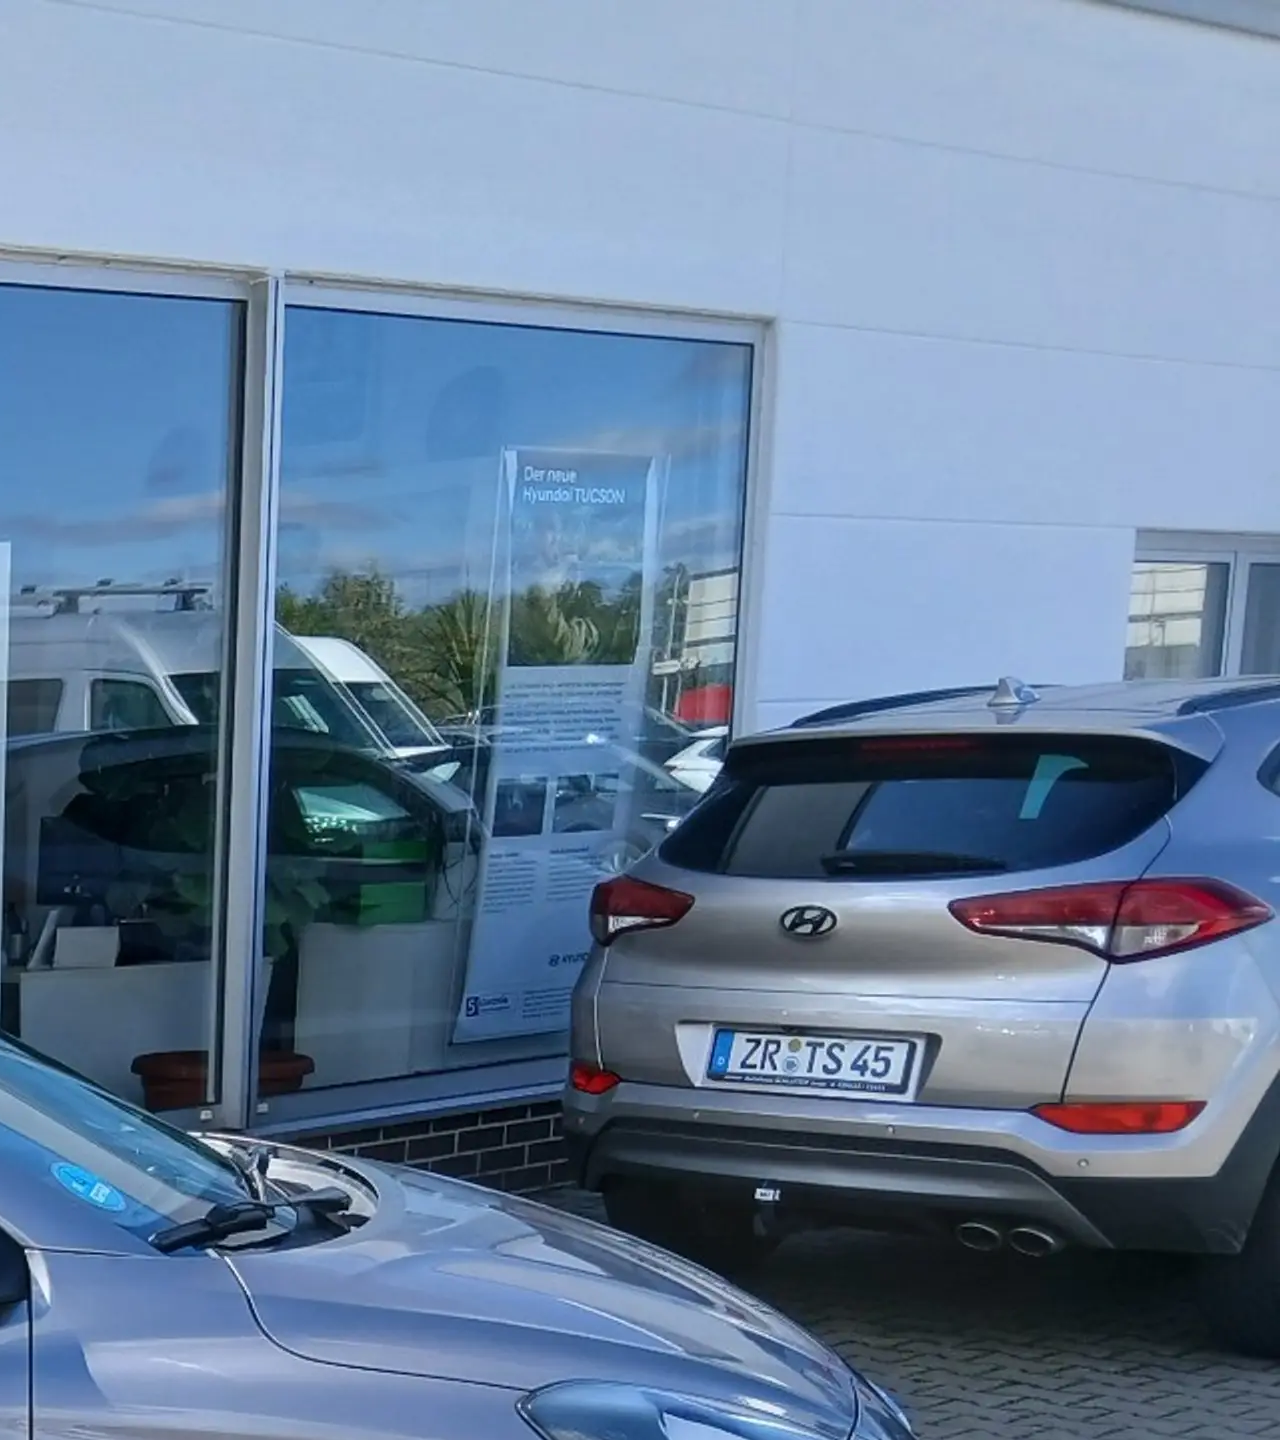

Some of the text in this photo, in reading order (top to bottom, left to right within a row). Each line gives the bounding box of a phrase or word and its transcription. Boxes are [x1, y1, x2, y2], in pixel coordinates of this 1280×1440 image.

[574, 487, 626, 503] TUCSON
[740, 1038, 782, 1071] ZR
[805, 1041, 845, 1075] TS
[850, 1044, 895, 1078] 45
